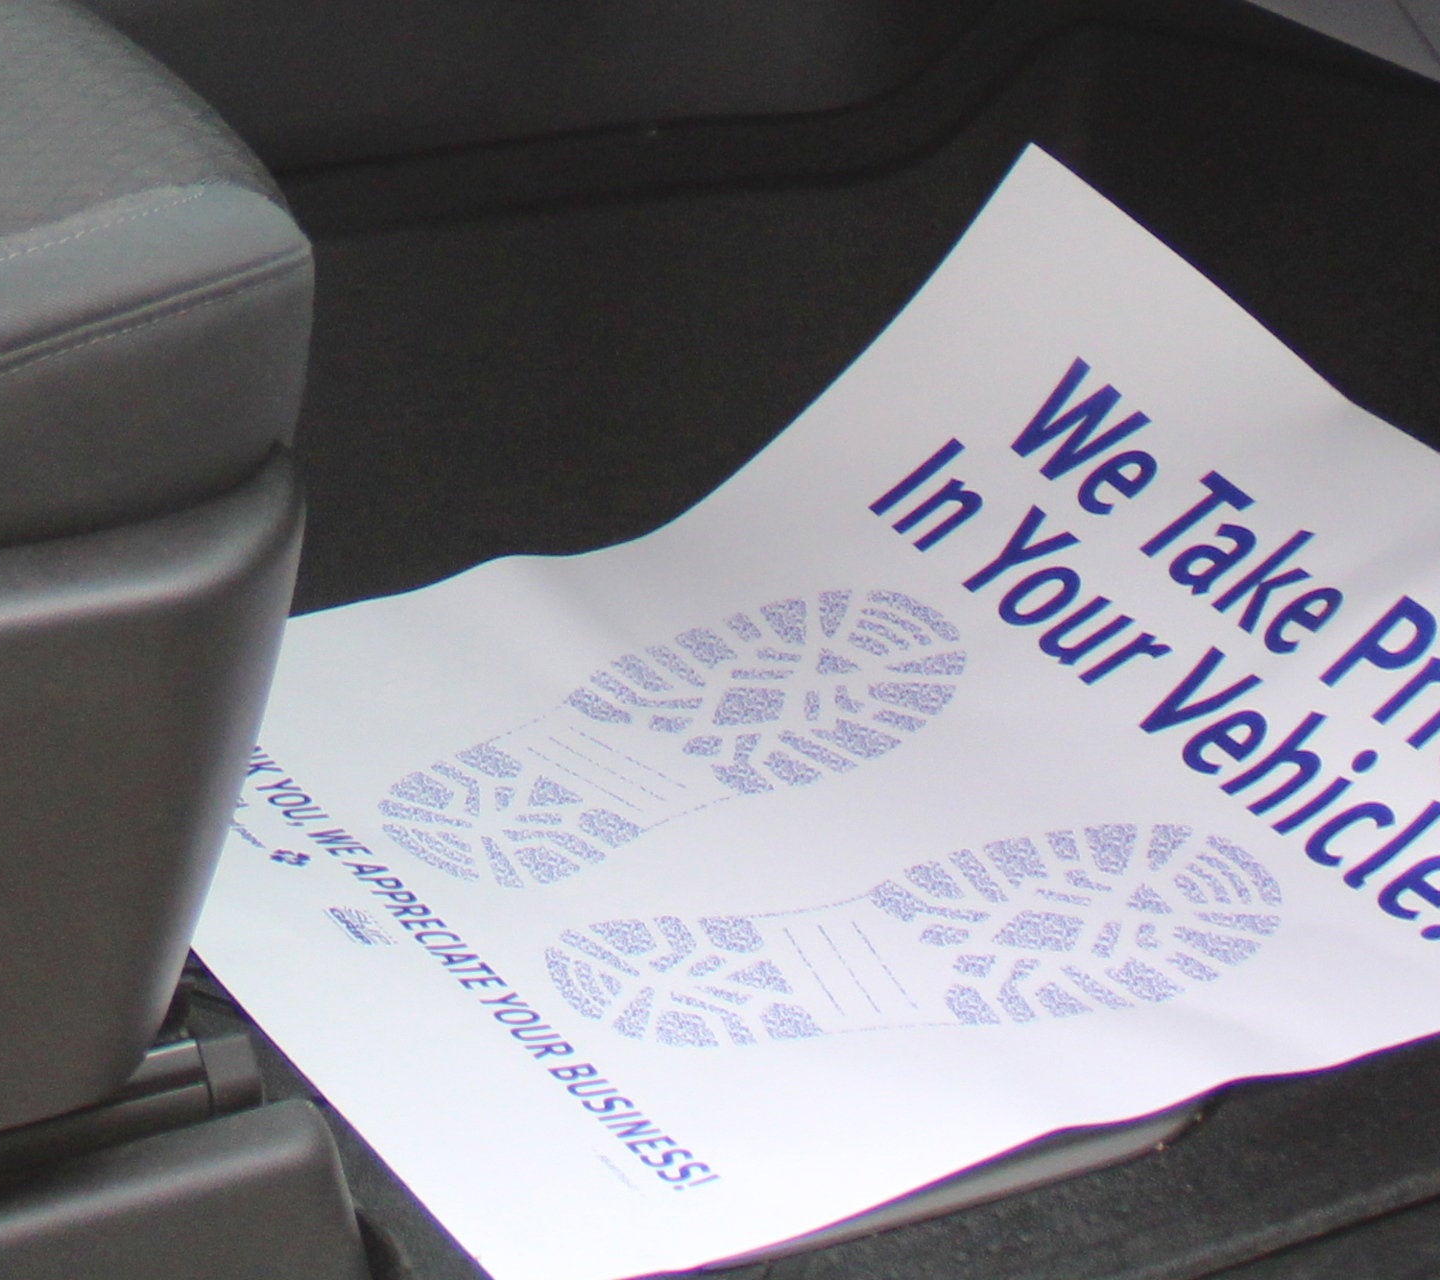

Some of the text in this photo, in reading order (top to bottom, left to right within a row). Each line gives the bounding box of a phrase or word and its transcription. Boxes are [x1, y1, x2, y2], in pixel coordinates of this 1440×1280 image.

[868, 437, 983, 552] In
[961, 505, 1173, 686] Your
[1010, 356, 1158, 515] We
[1139, 470, 1343, 654] Take
[255, 777, 329, 827] YOU,
[306, 828, 373, 857] WE
[341, 861, 507, 990] APPRECIATE
[479, 992, 574, 1059] YOUR
[548, 1063, 720, 1191] BUSINESS!
